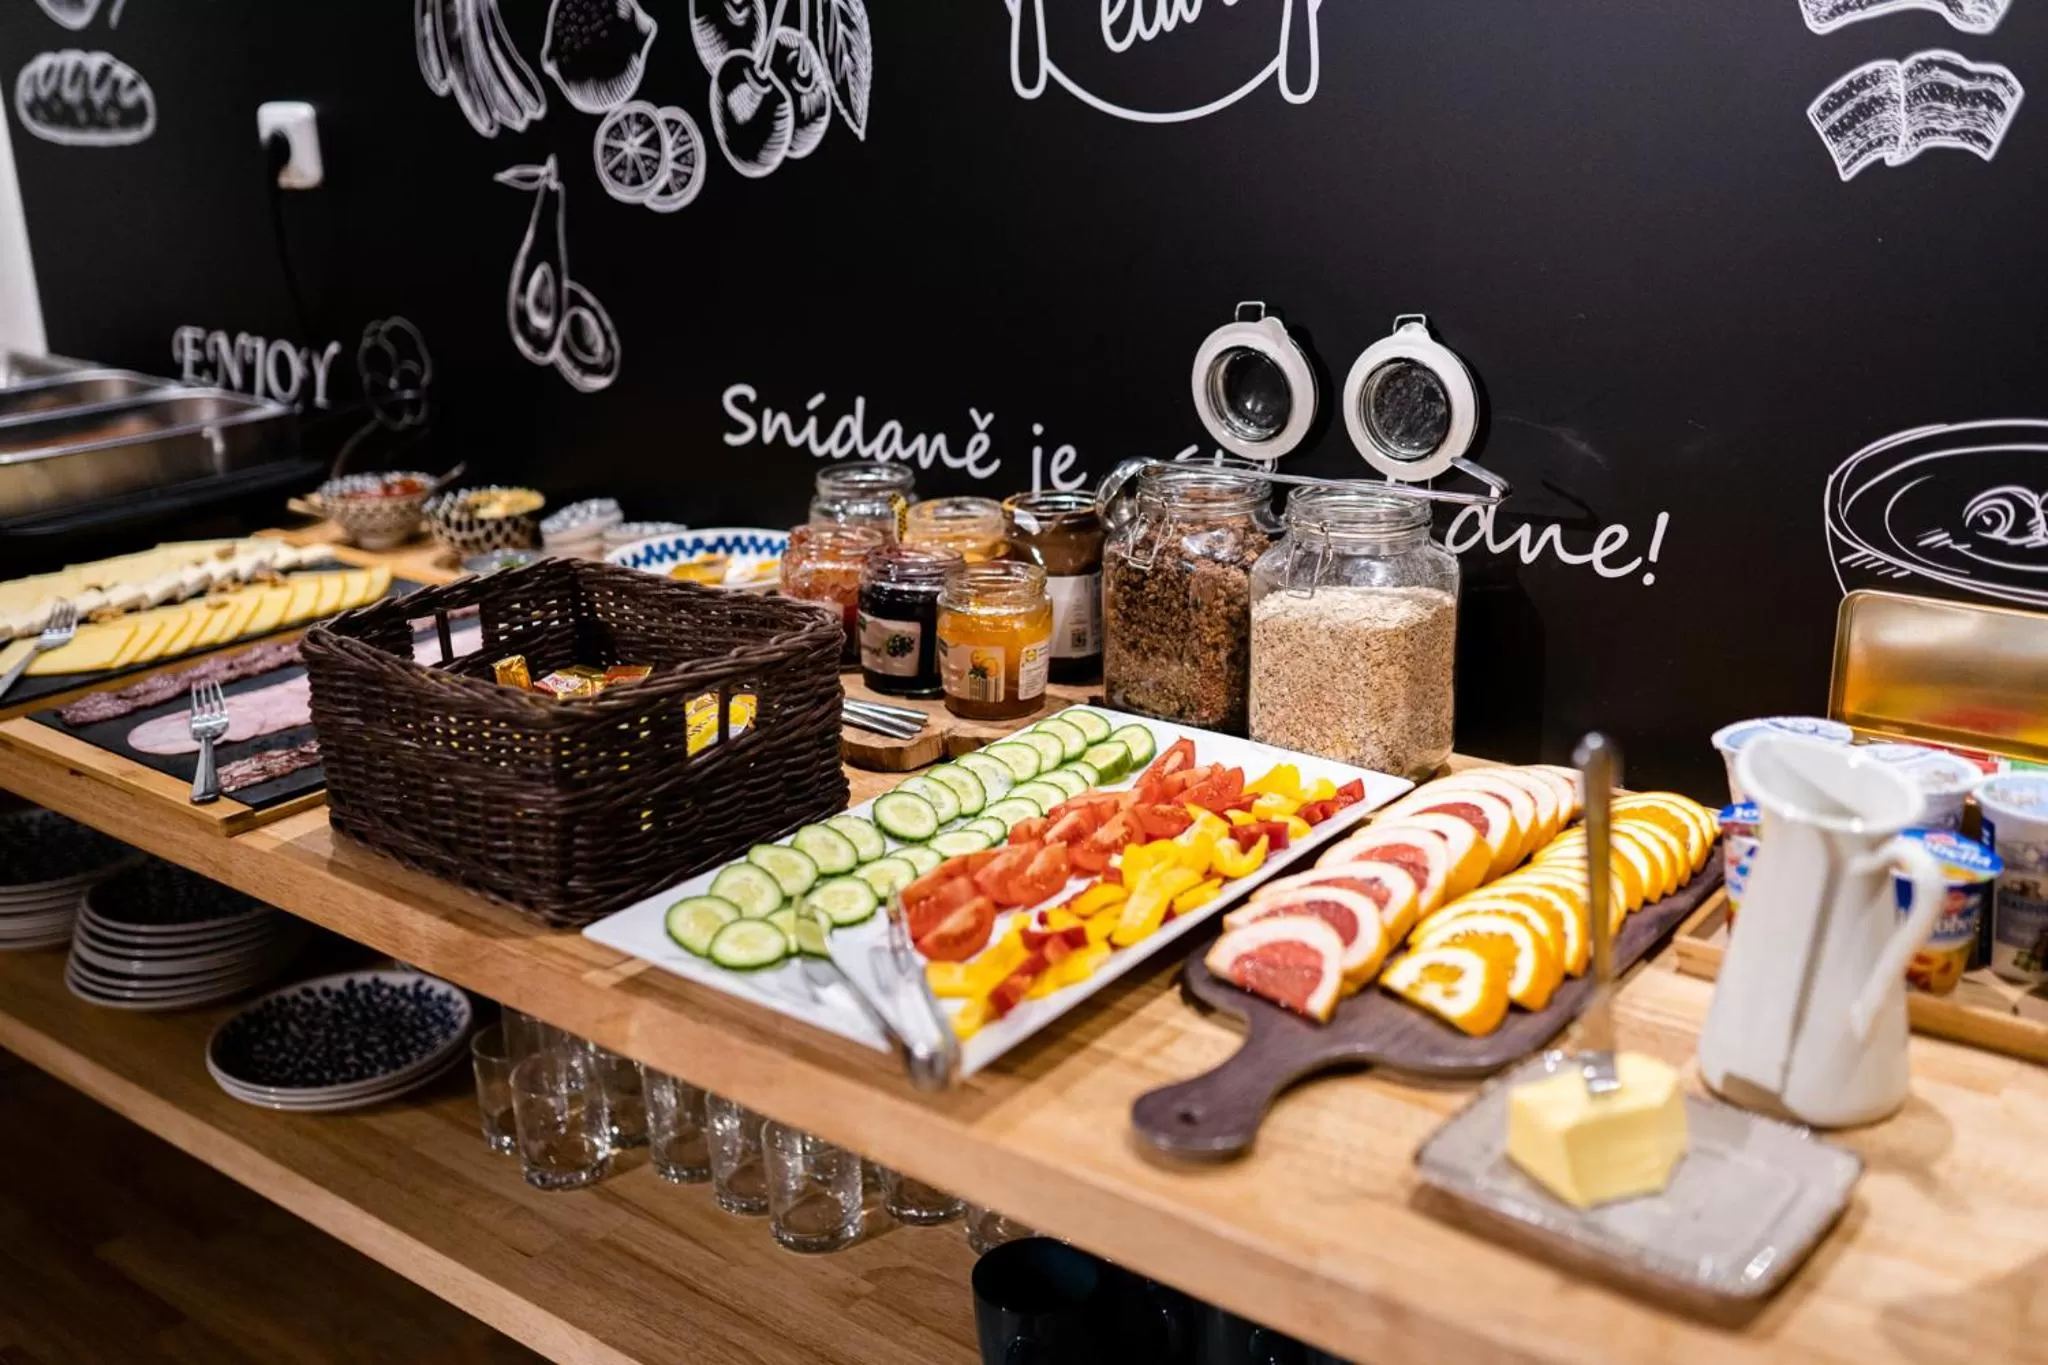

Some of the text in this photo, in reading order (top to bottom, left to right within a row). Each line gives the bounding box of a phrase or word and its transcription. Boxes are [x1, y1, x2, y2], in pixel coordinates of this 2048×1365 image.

[172, 325, 342, 409] ENJOY
[721, 382, 1001, 479] Snídaně
[1031, 423, 1088, 492] je
